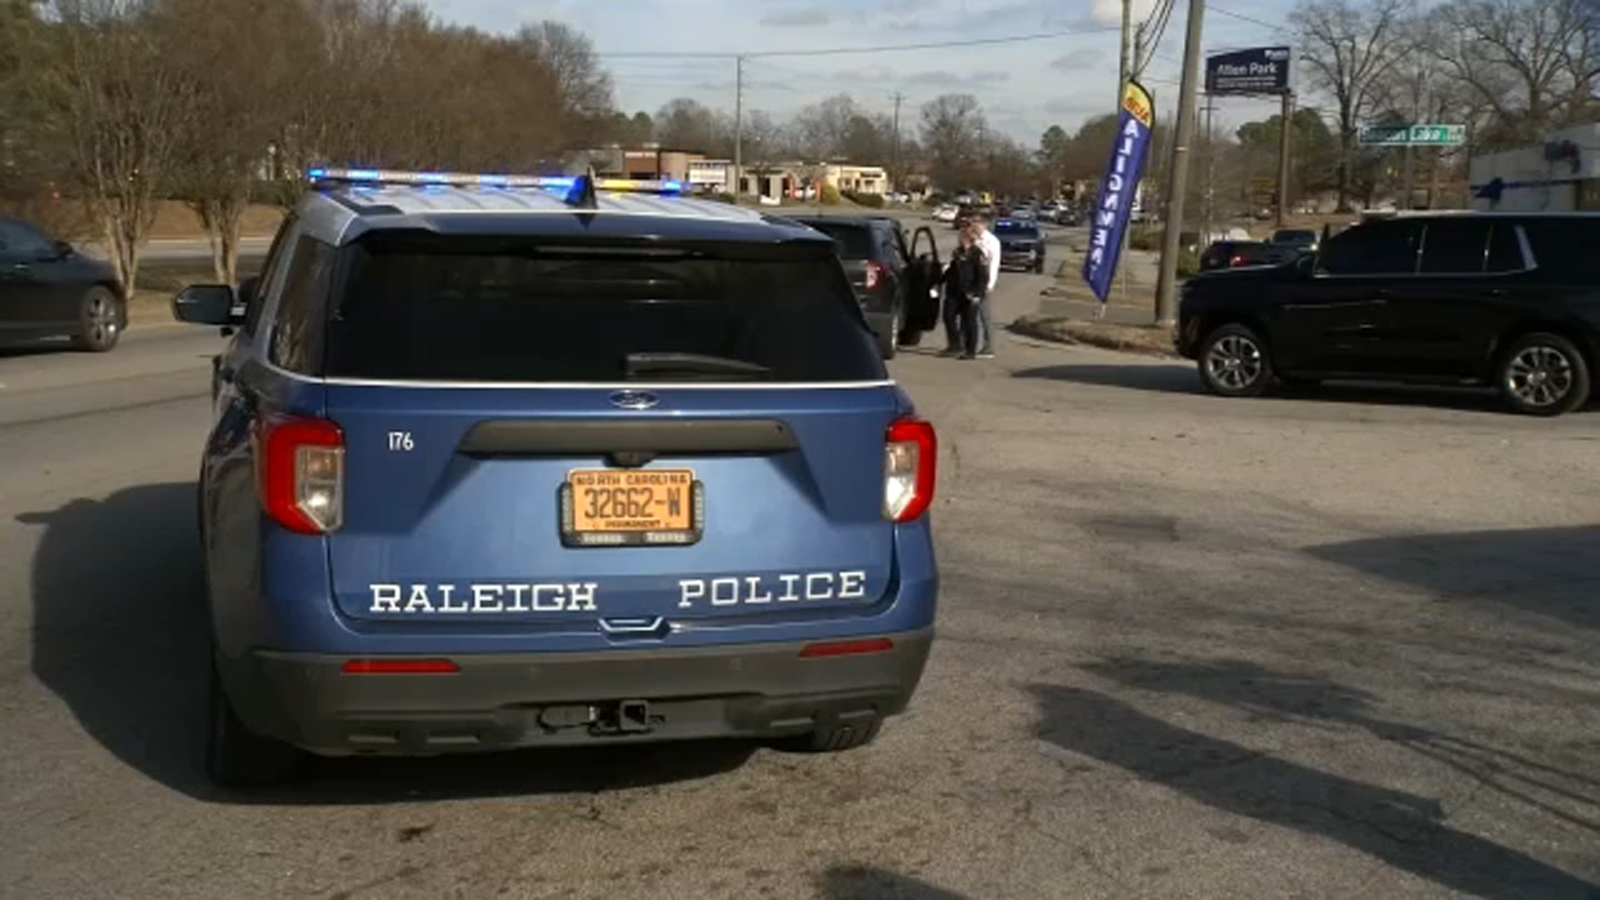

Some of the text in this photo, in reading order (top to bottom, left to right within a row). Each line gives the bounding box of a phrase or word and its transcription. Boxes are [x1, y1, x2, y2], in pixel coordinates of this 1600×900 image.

[1249, 62, 1278, 75] Park
[1410, 126, 1441, 141] Lake
[388, 432, 414, 451] 176
[577, 474, 687, 485] NORTH CAROLINA
[369, 570, 866, 613] RALEIGH POLICE
